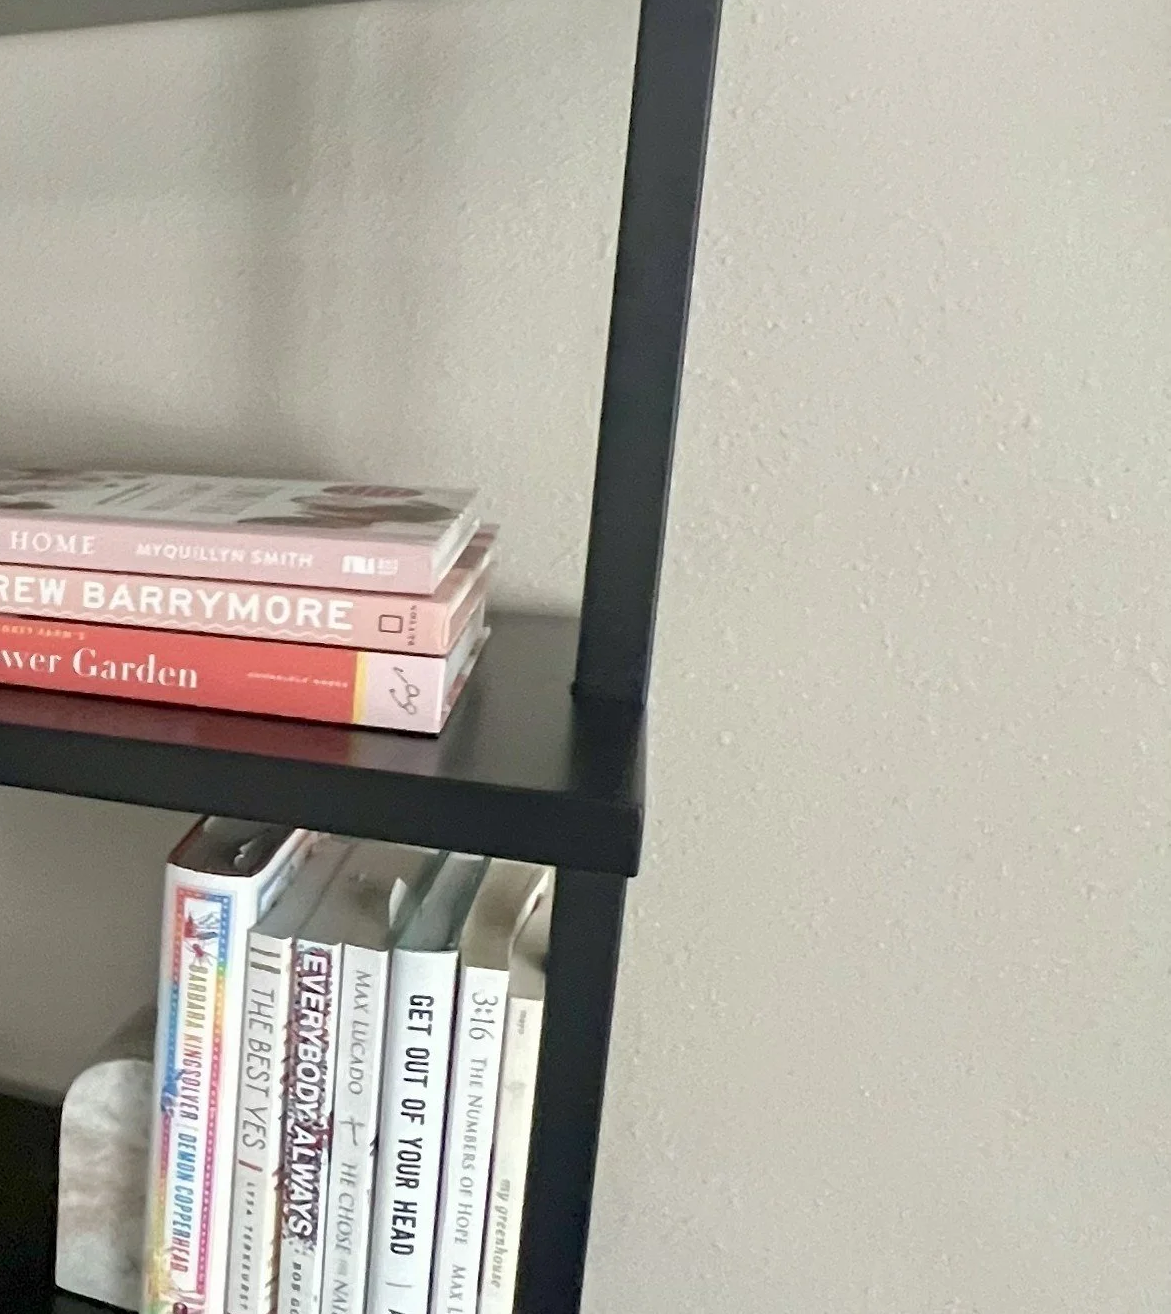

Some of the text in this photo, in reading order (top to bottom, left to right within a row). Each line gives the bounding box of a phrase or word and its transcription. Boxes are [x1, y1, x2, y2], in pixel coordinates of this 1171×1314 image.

[10, 531, 97, 555] HOME
[135, 543, 314, 567] MYQUILLYN SMITH
[83, 580, 354, 631] BARRYMORE
[72, 646, 198, 689] Garden
[355, 970, 373, 1013] MAX
[244, 988, 275, 1150] THE BEST YES
[350, 1019, 370, 1096] LUCADO
[171, 964, 209, 1273] BARBARA KINGSOLVER DEMON COPPERHEAD
[391, 993, 435, 1256] GET OUT OF YOUR HEAD
[456, 991, 499, 1246] 3:16 THE NUMBERS OF HOPE
[290, 1124, 317, 1237] ALWAYS
[337, 1190, 355, 1255] CHOSE
[493, 1177, 512, 1289] my greenhouse
[292, 1261, 302, 1292] BOB
[451, 1263, 466, 1300] MAX
